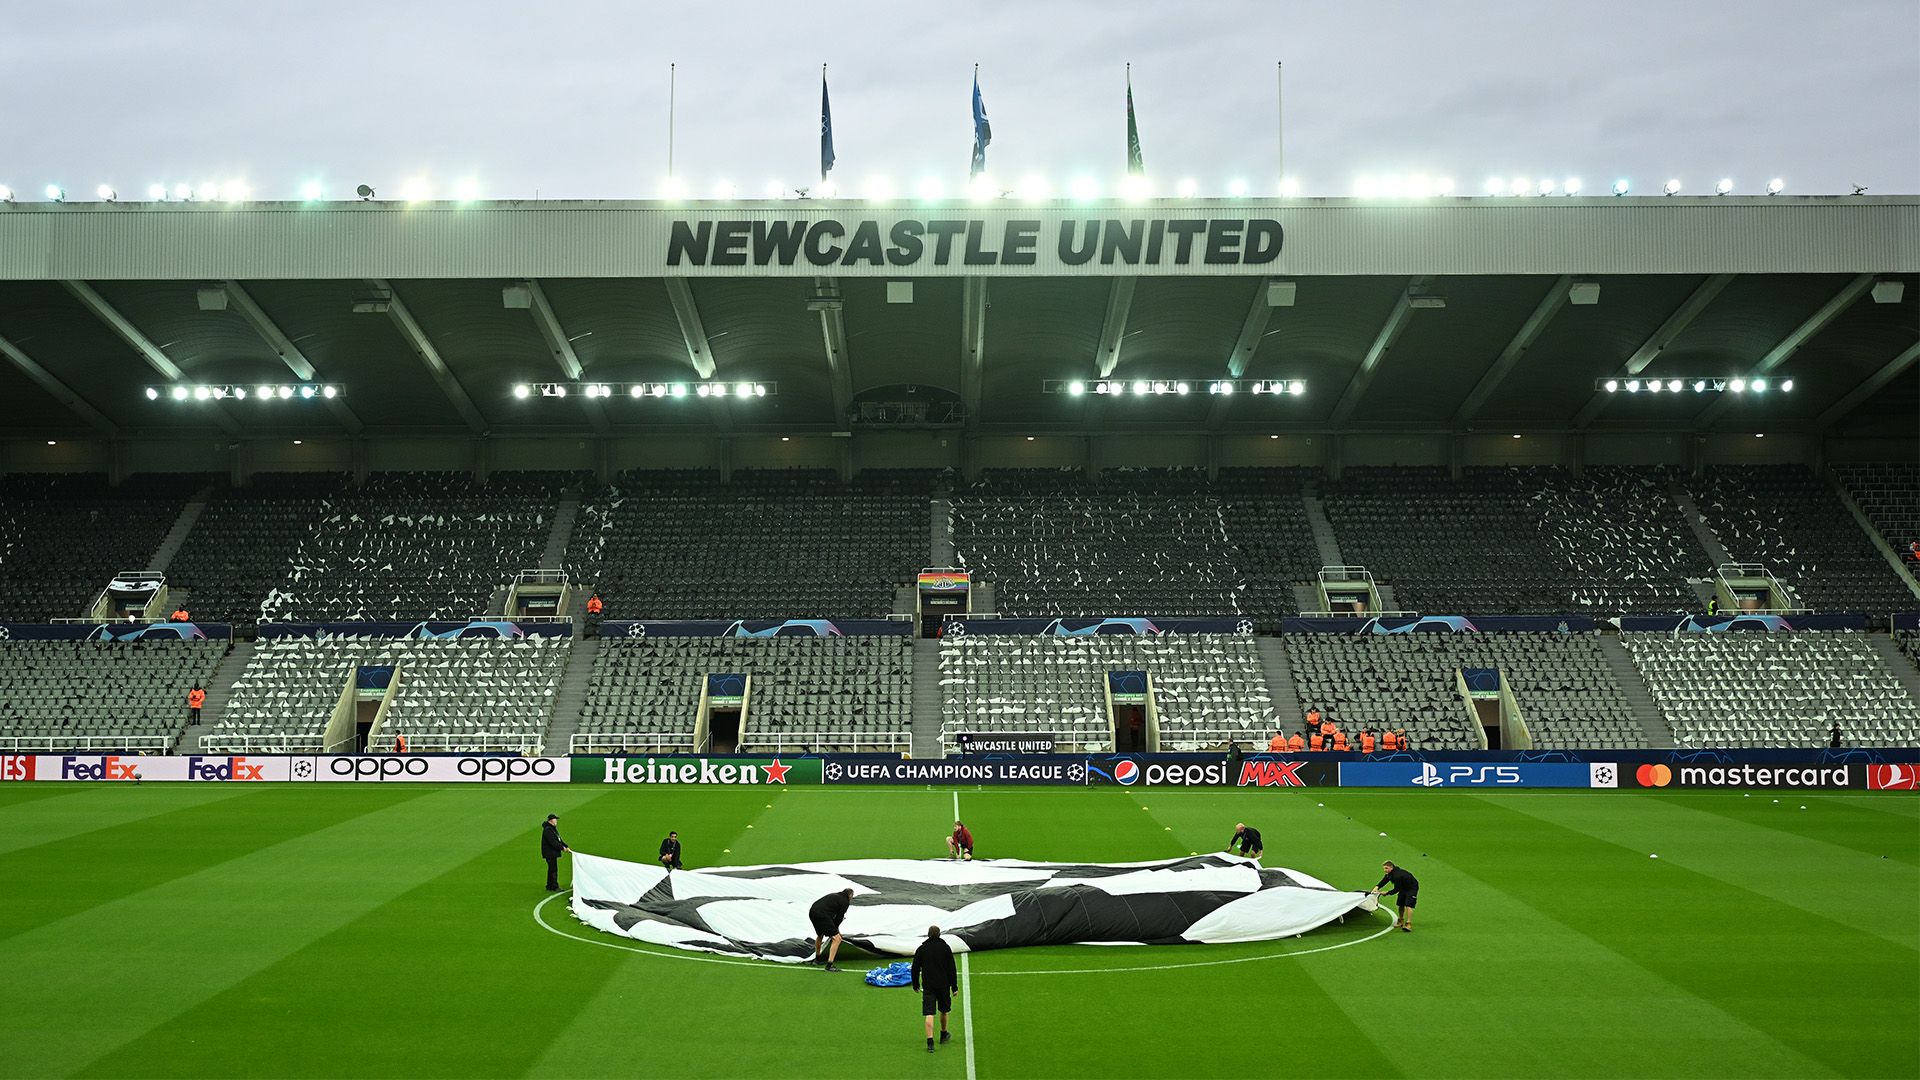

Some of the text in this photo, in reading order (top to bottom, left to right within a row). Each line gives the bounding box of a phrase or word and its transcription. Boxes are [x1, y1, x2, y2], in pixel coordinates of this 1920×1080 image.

[667, 219, 1284, 266] NEWCASTLE UNITED
[964, 740, 1052, 751] NEWCASTLE UNITED
[0, 756, 27, 781] ES
[62, 756, 138, 780] FedEx
[188, 756, 264, 780] FedEx
[330, 757, 429, 781] oppo
[457, 757, 556, 781] oppo
[602, 757, 759, 784] Heineken
[847, 764, 1063, 779] UEFA CHAMPIONS LEAGUE
[1145, 760, 1309, 787] pepsi MAX
[1450, 766, 1520, 783] PS5
[1680, 764, 1850, 786] mastercard
